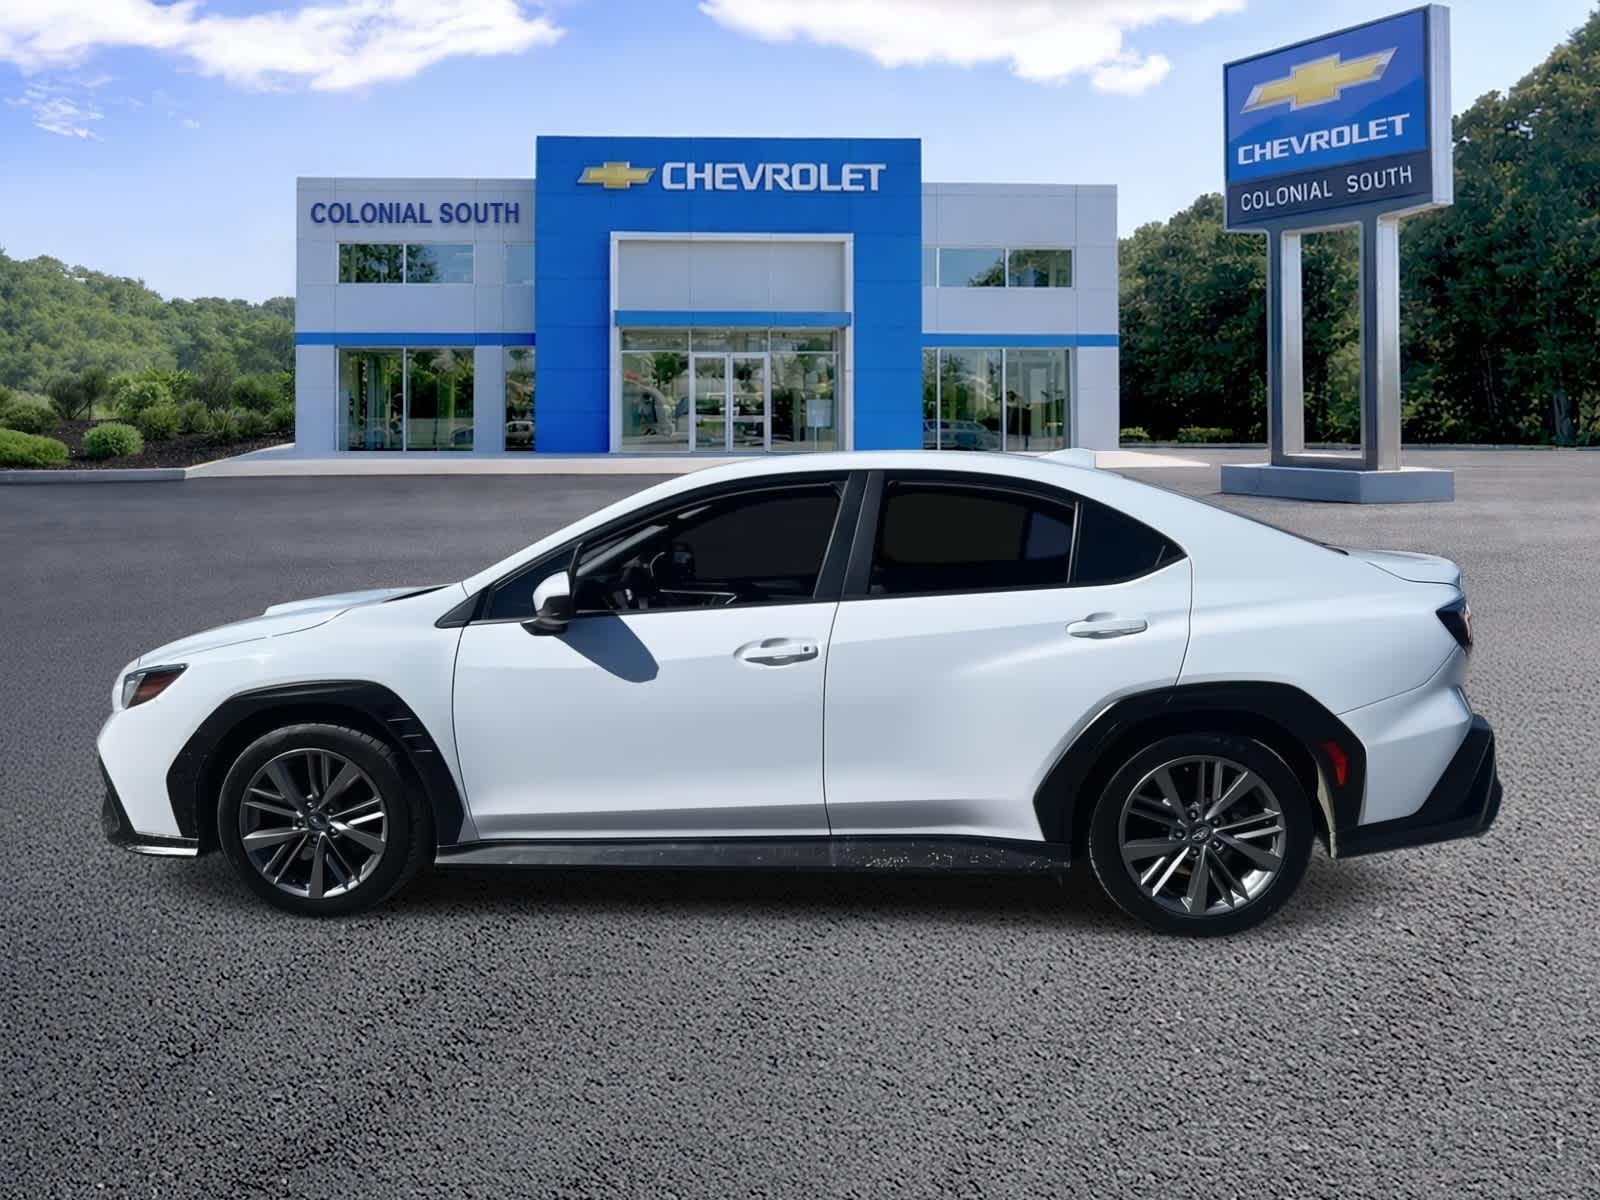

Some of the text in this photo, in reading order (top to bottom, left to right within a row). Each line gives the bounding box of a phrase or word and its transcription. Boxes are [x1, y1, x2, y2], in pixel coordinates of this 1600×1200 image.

[1238, 113, 1410, 165] CHEVROLET
[662, 162, 887, 192] CHEVROLET
[1241, 165, 1412, 211] COLONIAL SOUTH
[310, 202, 521, 225] COLONIAL SOUTH
